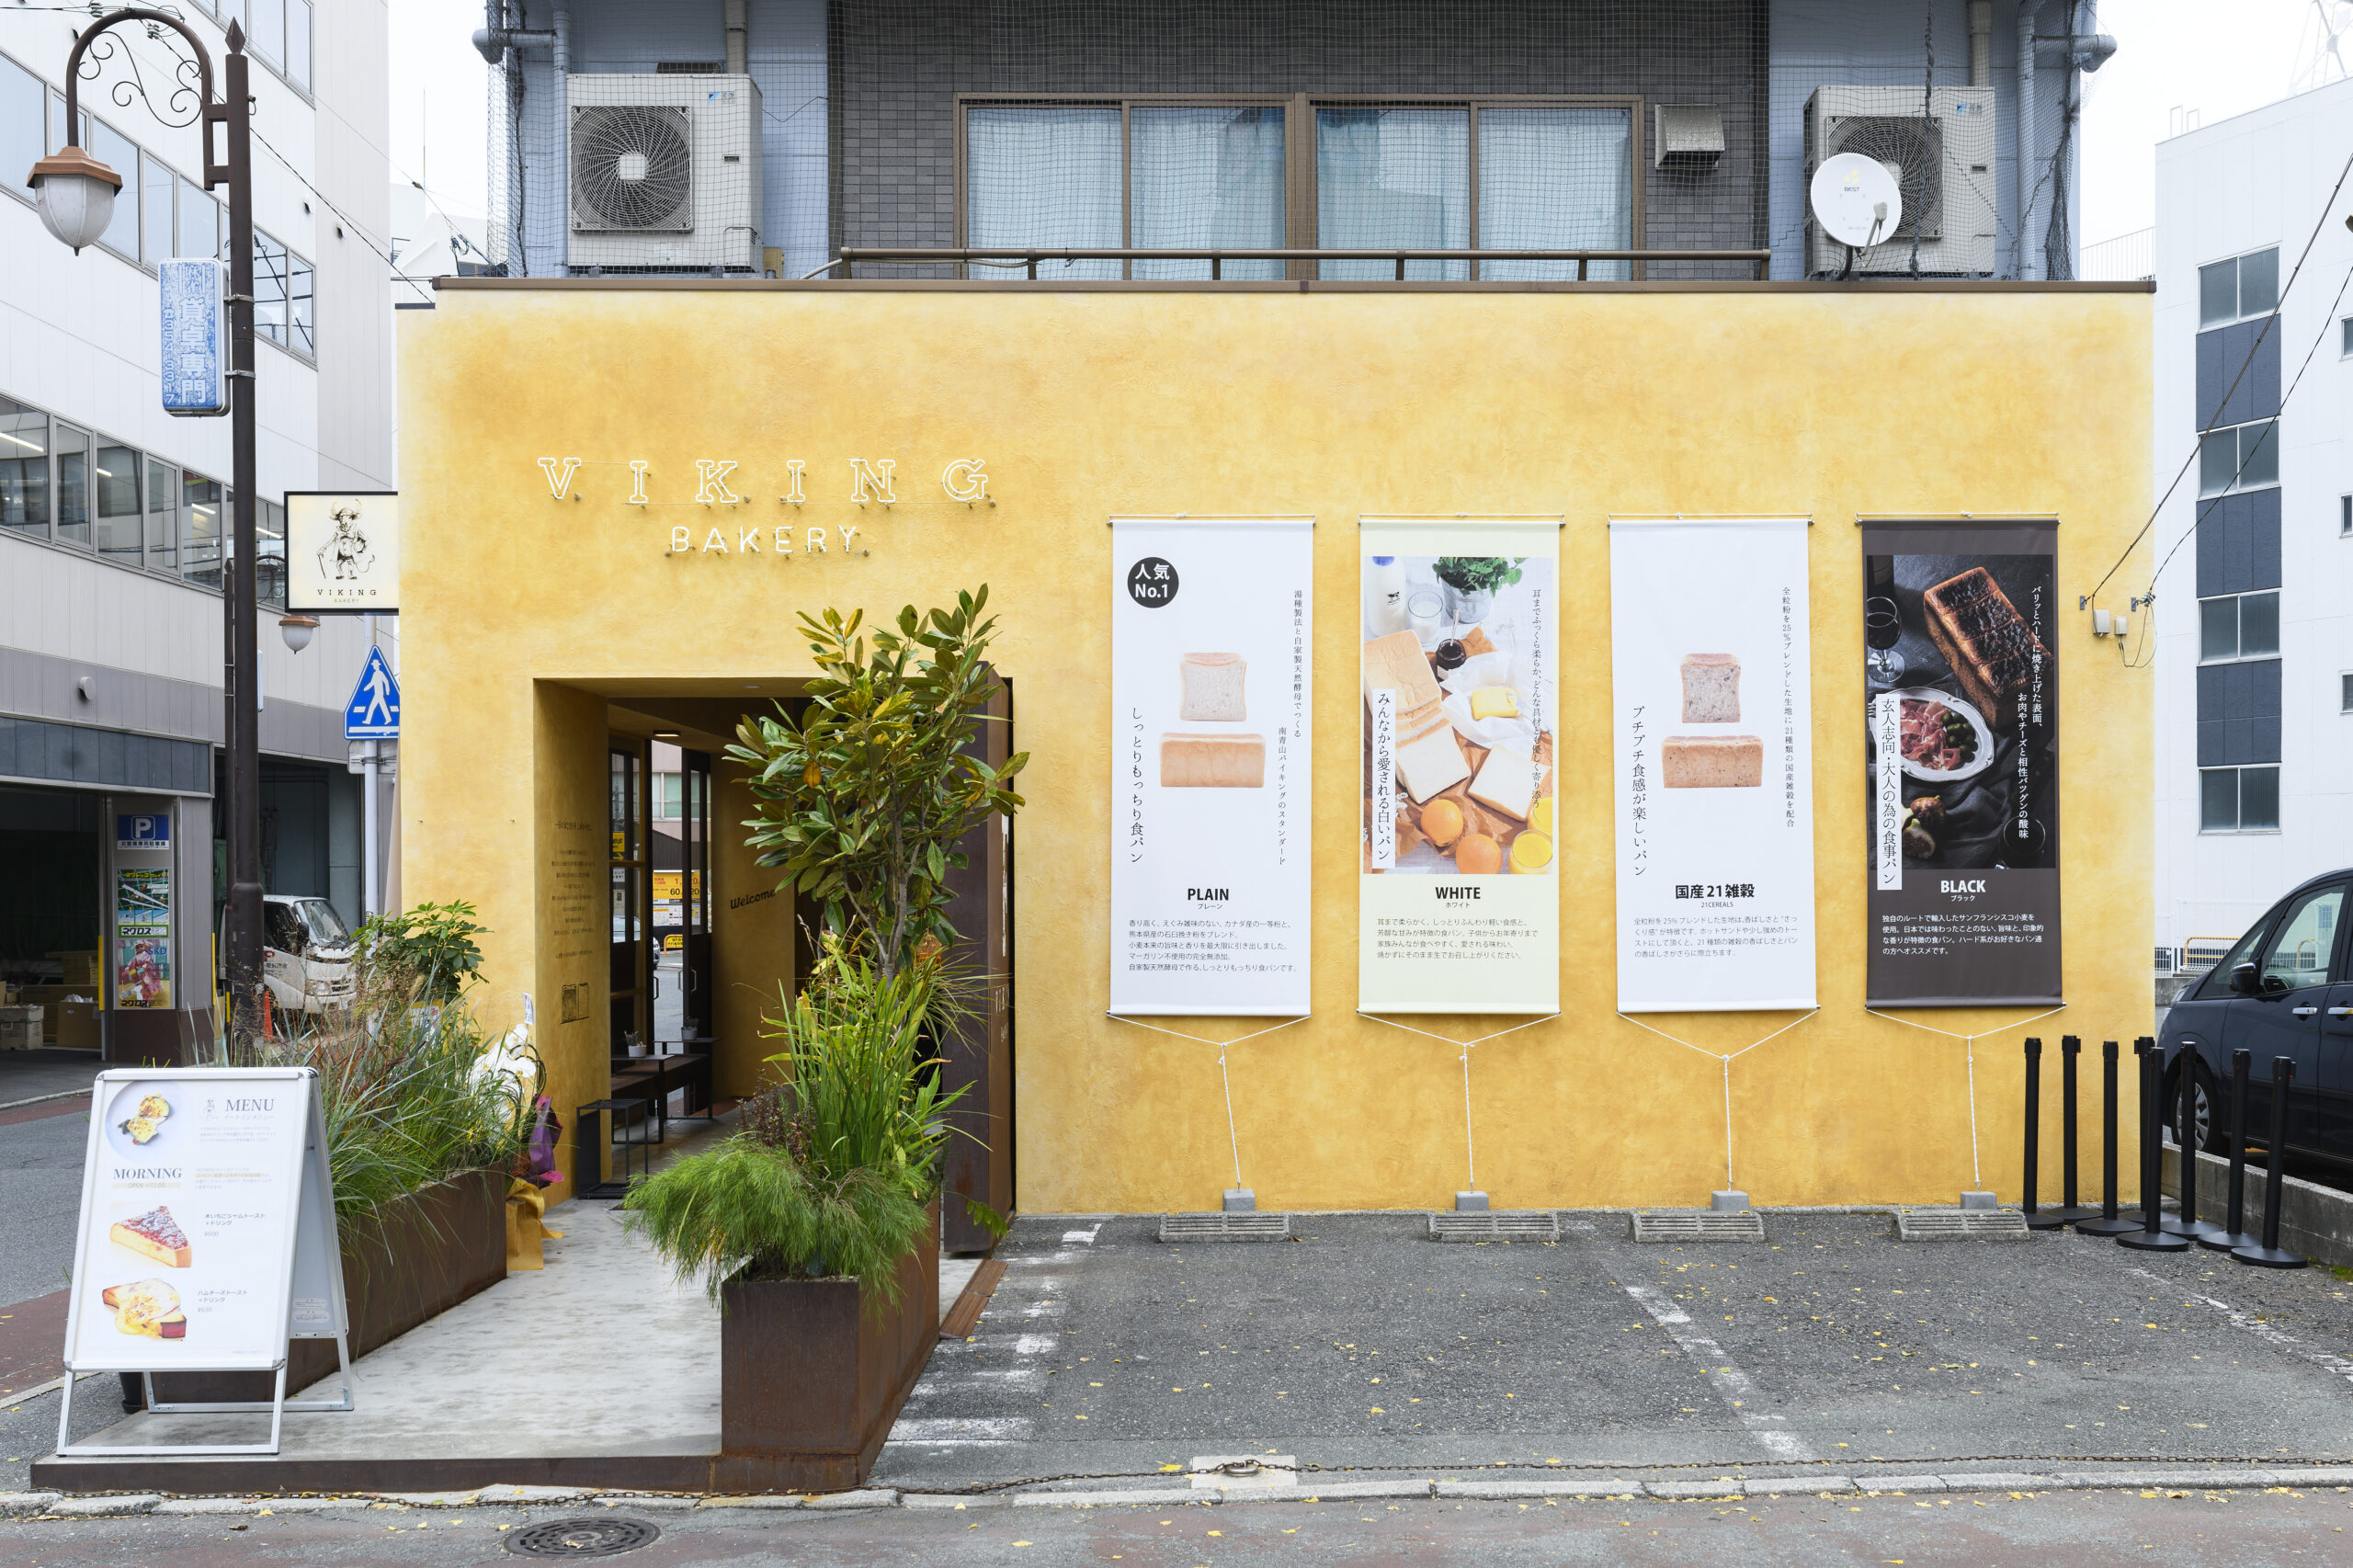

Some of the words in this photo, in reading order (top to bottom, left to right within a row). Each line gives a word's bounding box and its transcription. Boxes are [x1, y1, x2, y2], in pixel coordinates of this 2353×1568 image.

[538, 458, 988, 504] VIKING
[670, 525, 858, 553] BAKERY
[1134, 563, 1170, 581] 人気
[1134, 584, 1168, 598] No.1
[2018, 693, 2029, 838] お肉やチーズと相性バツグンの酸味
[1130, 708, 1144, 863] しっとりもっちり食パン
[1378, 693, 1391, 859] みんなから愛される白いパン
[1632, 706, 1646, 875] プチプチ食感が楽しいパン
[1881, 699, 1897, 884] 玄人志向・大人の為の食事パン
[135, 818, 151, 837] P
[1188, 889, 1229, 901] PLAIN
[1436, 887, 1481, 899] WHITE
[1675, 883, 1755, 899] 国産21雑穀
[1941, 881, 1986, 892] BLACK
[730, 890, 775, 909] Welcome
[225, 1098, 275, 1111] MENU
[113, 1167, 182, 1179] MORNING
